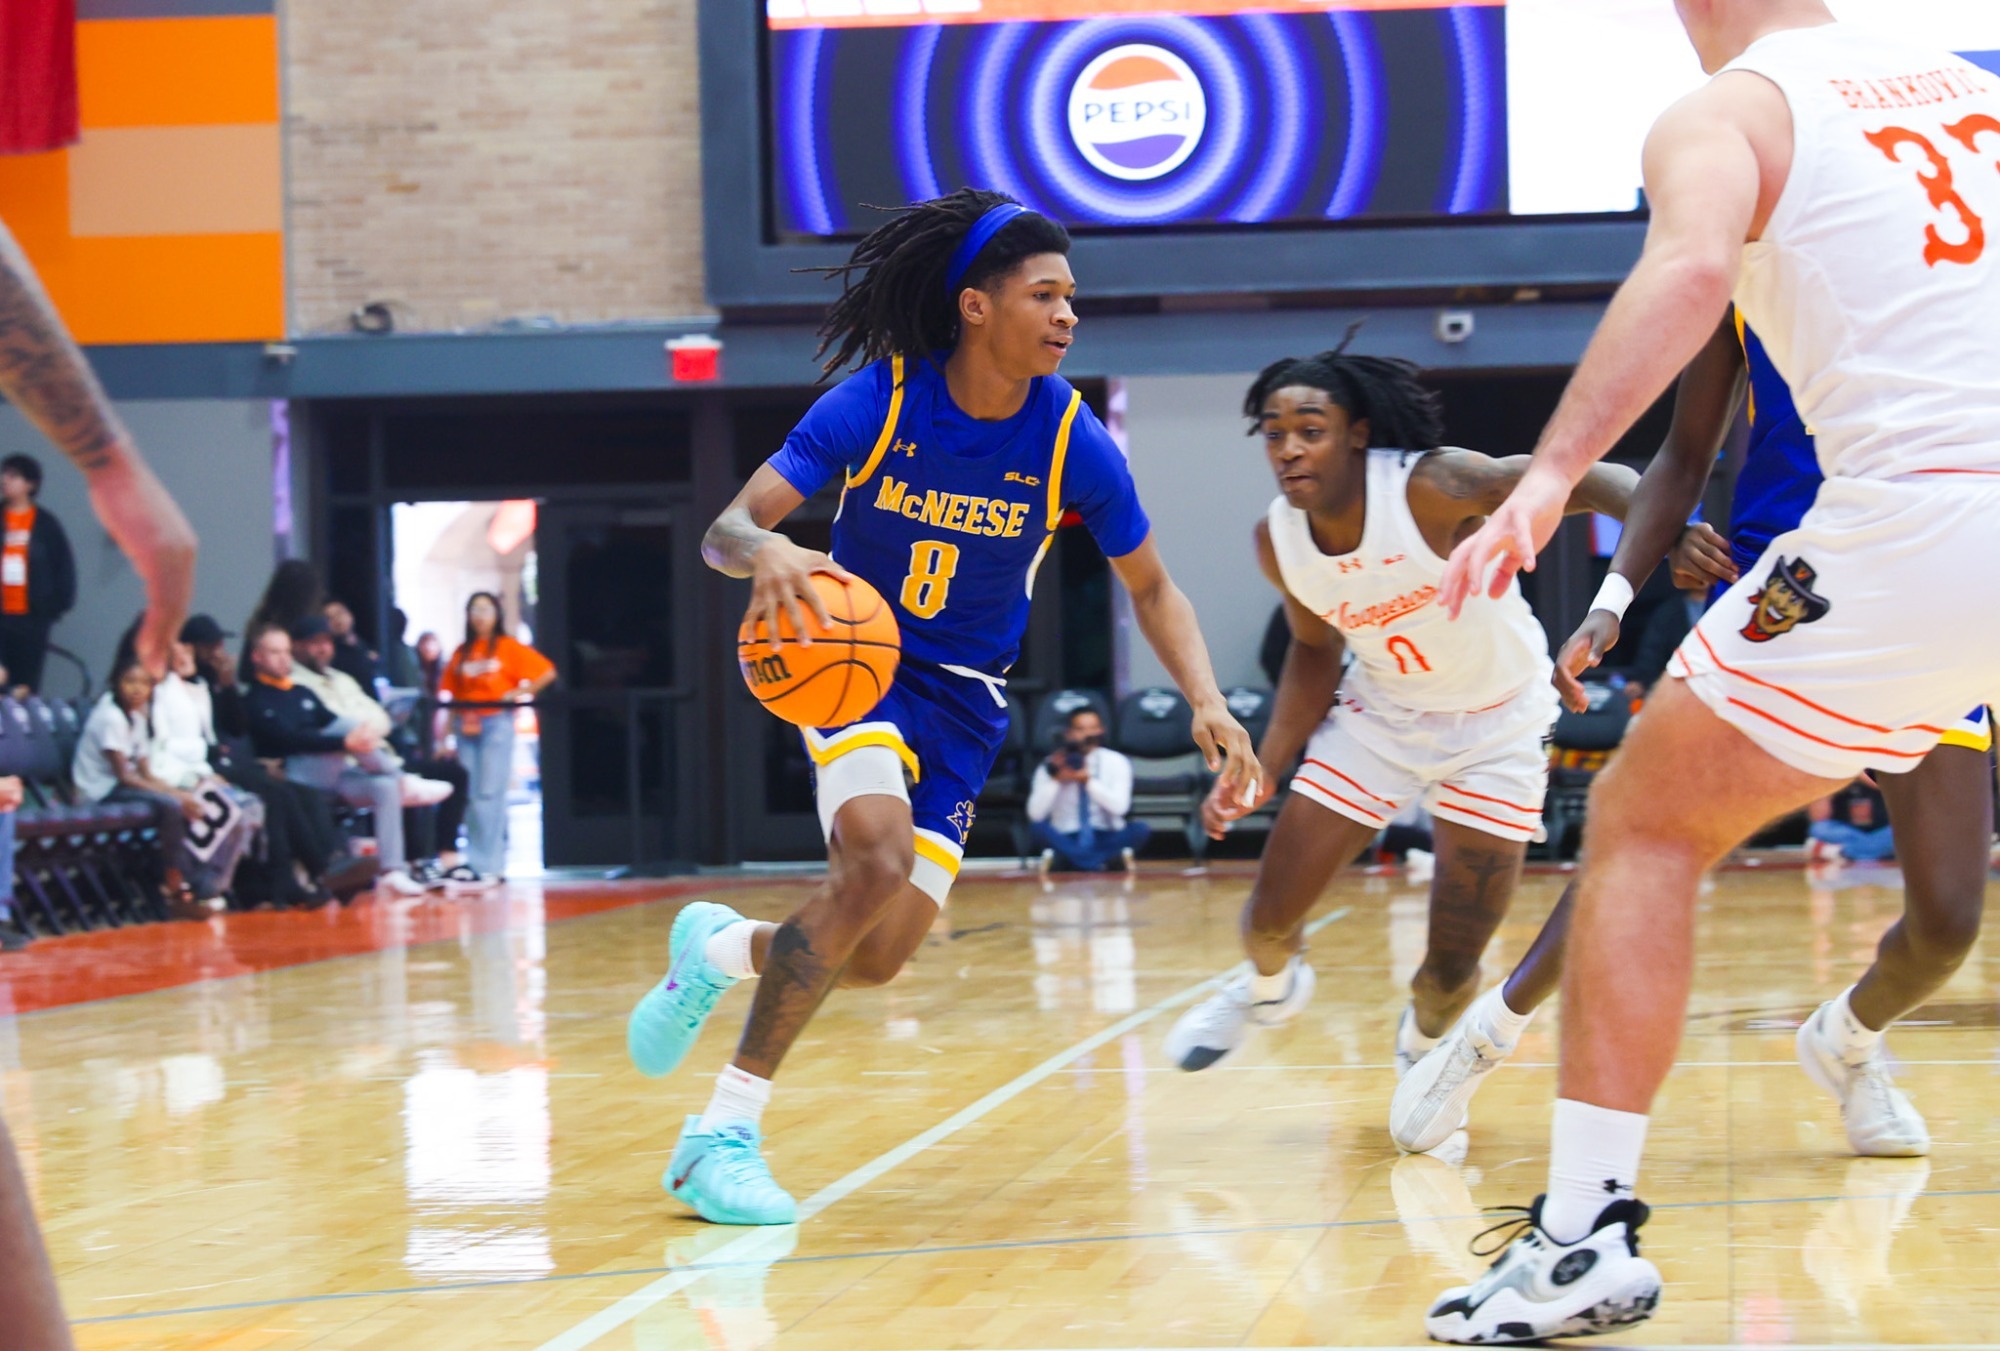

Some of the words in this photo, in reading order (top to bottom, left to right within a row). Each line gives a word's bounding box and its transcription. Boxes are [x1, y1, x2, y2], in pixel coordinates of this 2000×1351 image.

[1084, 100, 1190, 123] PEPSI
[873, 475, 1030, 538] McNEESE
[899, 539, 960, 620] 8
